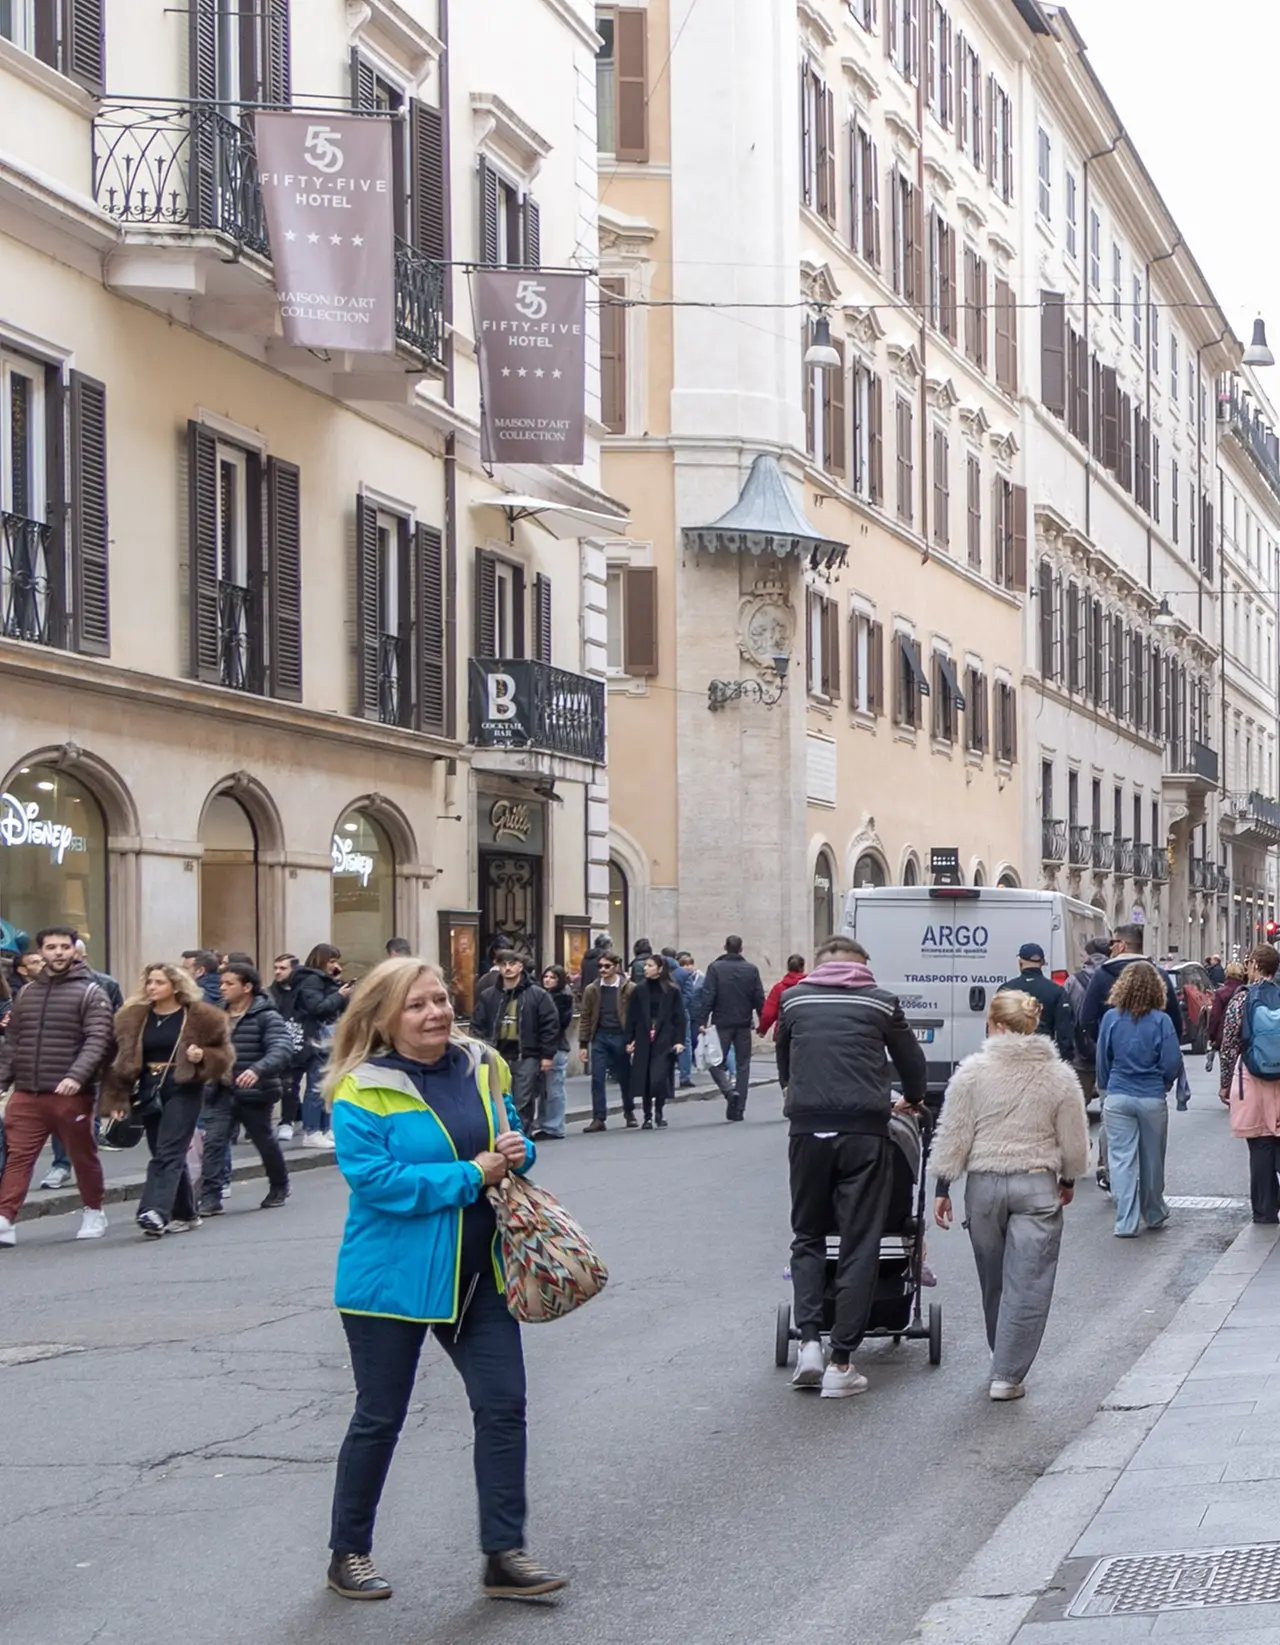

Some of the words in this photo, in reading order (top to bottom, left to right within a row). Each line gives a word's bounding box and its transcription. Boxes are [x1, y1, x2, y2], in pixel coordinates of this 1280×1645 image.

[304, 125, 344, 173] 55
[260, 173, 387, 192] FIFTY-FIVE
[295, 193, 352, 208] HOTEL
[277, 292, 330, 306] MAISON
[334, 296, 376, 309] D'ART
[514, 280, 548, 319] 55
[281, 306, 370, 323] COLLECTION
[482, 320, 581, 335] FIFTY-FIVE
[509, 335, 553, 348] HOTEL
[494, 418, 536, 429] MAISON
[499, 430, 566, 441] COLLECTION
[487, 673, 517, 720] B
[481, 722, 524, 731] COCKTAIL
[494, 729, 512, 737] BAR
[921, 925, 988, 946] ARGO
[904, 974, 968, 983] TRASPORTO
[971, 975, 1007, 983] VALORI
